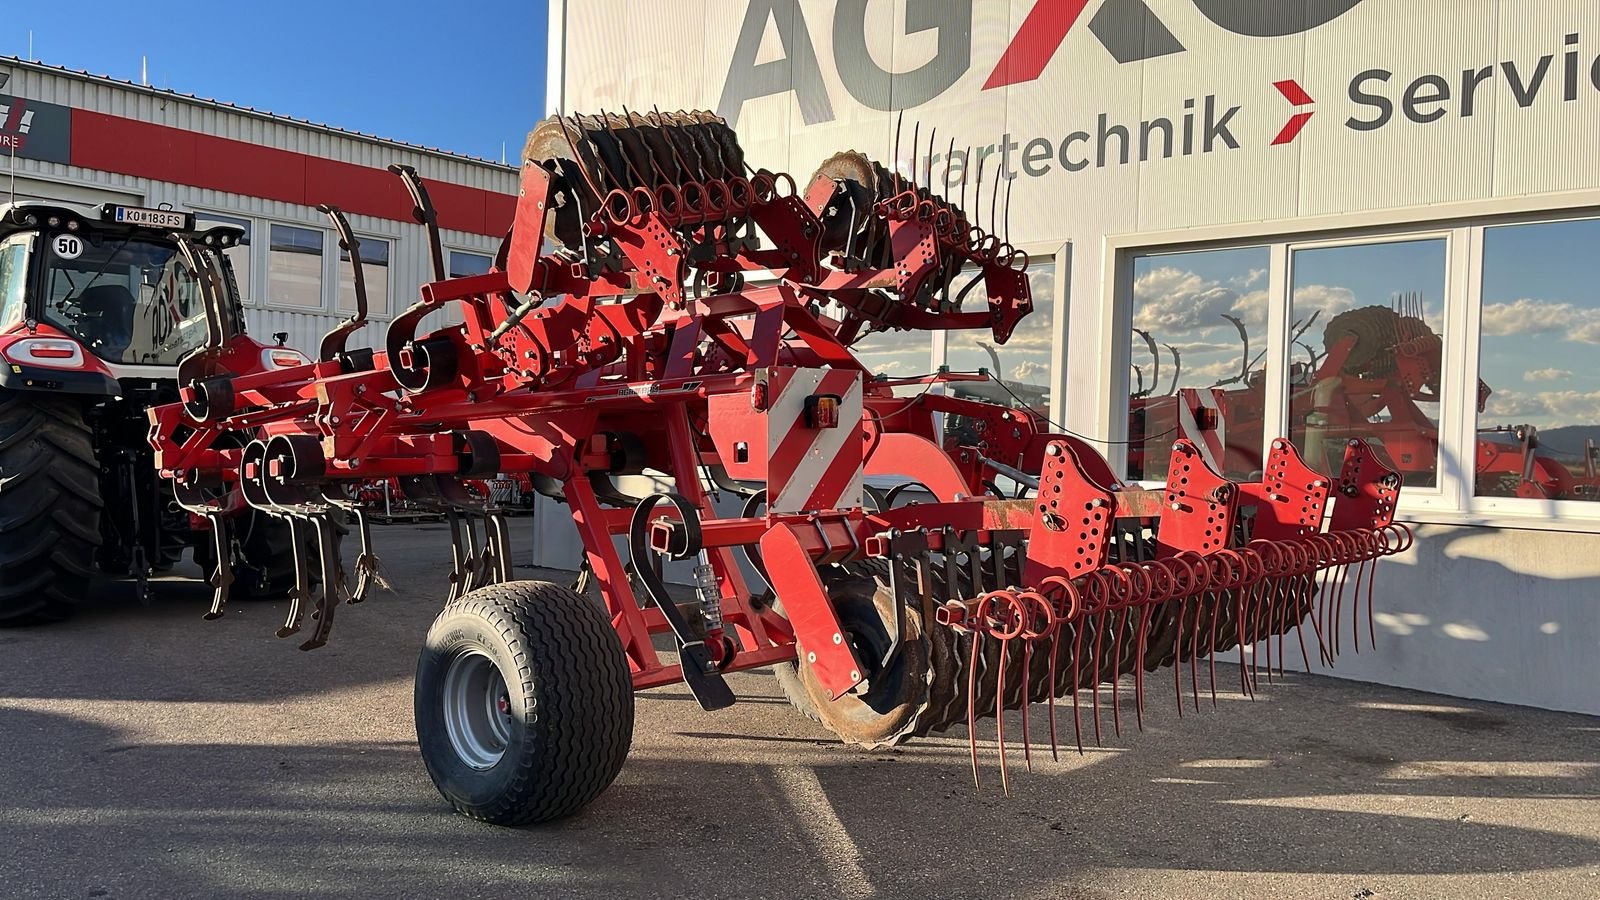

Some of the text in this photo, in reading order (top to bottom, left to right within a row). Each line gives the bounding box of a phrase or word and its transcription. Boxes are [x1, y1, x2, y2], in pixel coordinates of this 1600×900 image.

[909, 94, 1242, 189] rartechnik
[126, 210, 140, 222] KO
[58, 238, 78, 255] 50
